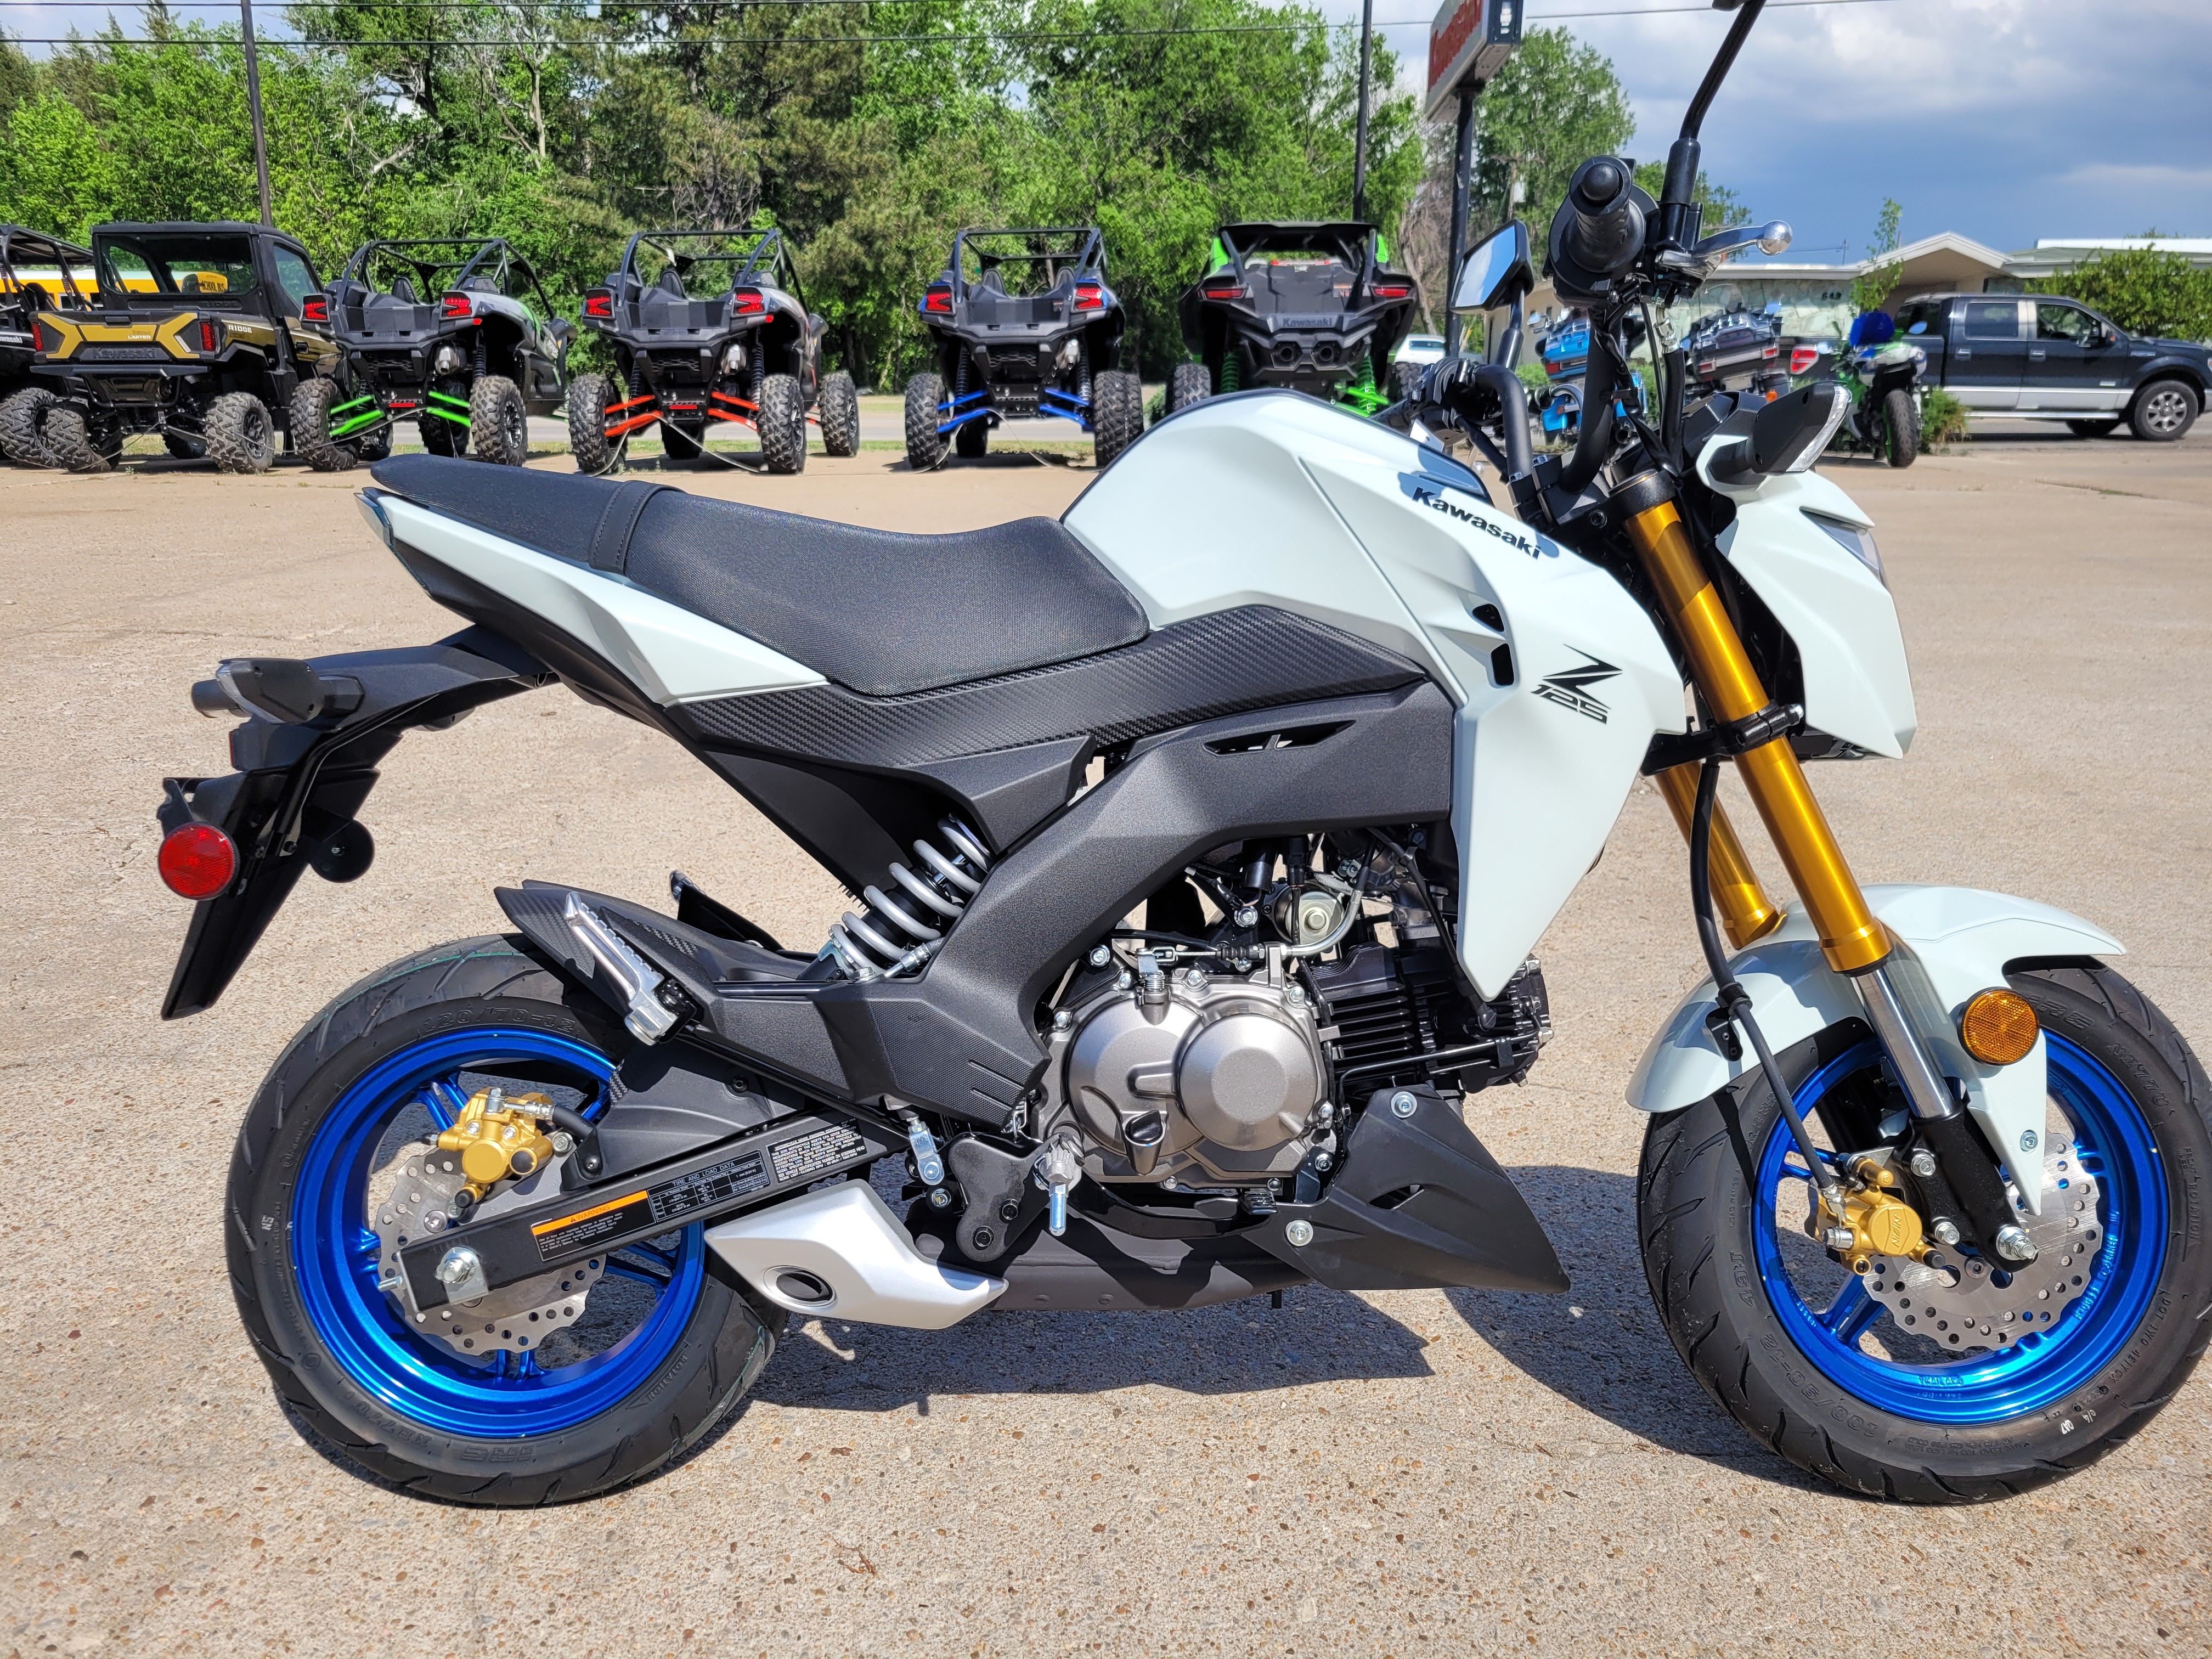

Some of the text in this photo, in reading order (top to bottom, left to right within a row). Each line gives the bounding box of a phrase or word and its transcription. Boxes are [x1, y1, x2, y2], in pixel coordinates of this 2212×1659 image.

[228, 324, 252, 334] RIDGE
[1283, 318, 1332, 326] Kawasaki
[92, 347, 156, 359] Kawasaki
[1412, 487, 1541, 560] Kawasaki
[1542, 644, 1623, 710] Z
[1530, 684, 1608, 725] 125
[423, 1007, 575, 1034] 120/70-12
[673, 1178, 686, 1187] TIRE
[702, 1168, 718, 1176] LOAD
[719, 1162, 735, 1170] DATA
[576, 1205, 610, 1220] WARNING
[2188, 1183, 2200, 1240] ROTATION
[2157, 1298, 2171, 1321] DOT
[648, 1355, 688, 1401] ROTATION
[1759, 1333, 1879, 1438] 100/90-12
